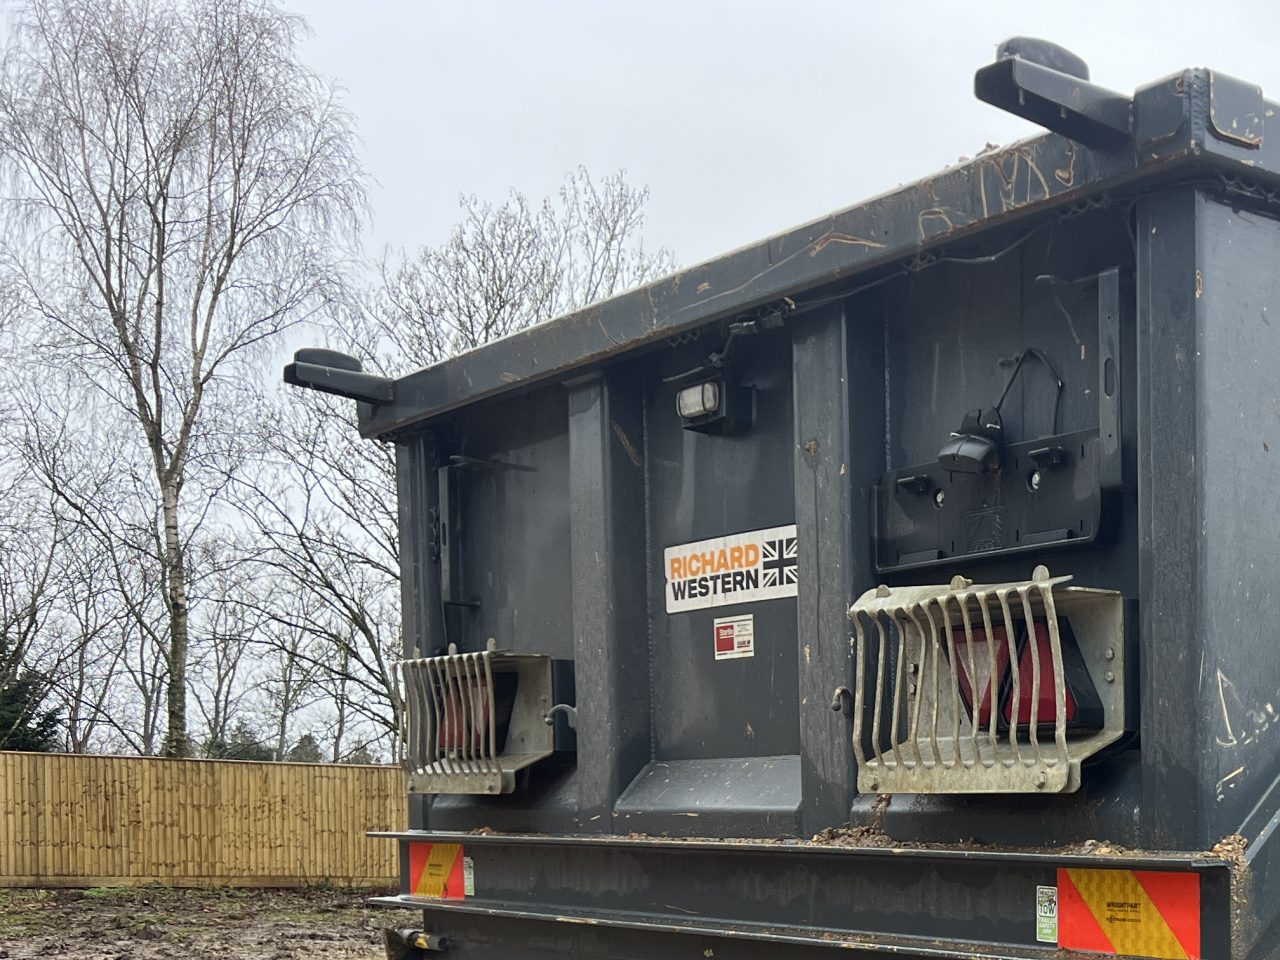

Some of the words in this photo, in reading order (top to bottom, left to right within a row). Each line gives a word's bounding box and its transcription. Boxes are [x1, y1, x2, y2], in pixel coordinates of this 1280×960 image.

[669, 543, 760, 581] RICHARD
[671, 568, 759, 601] WESTERN
[1039, 904, 1055, 915] TOW
[1106, 901, 1142, 909] WRIGHTPART
